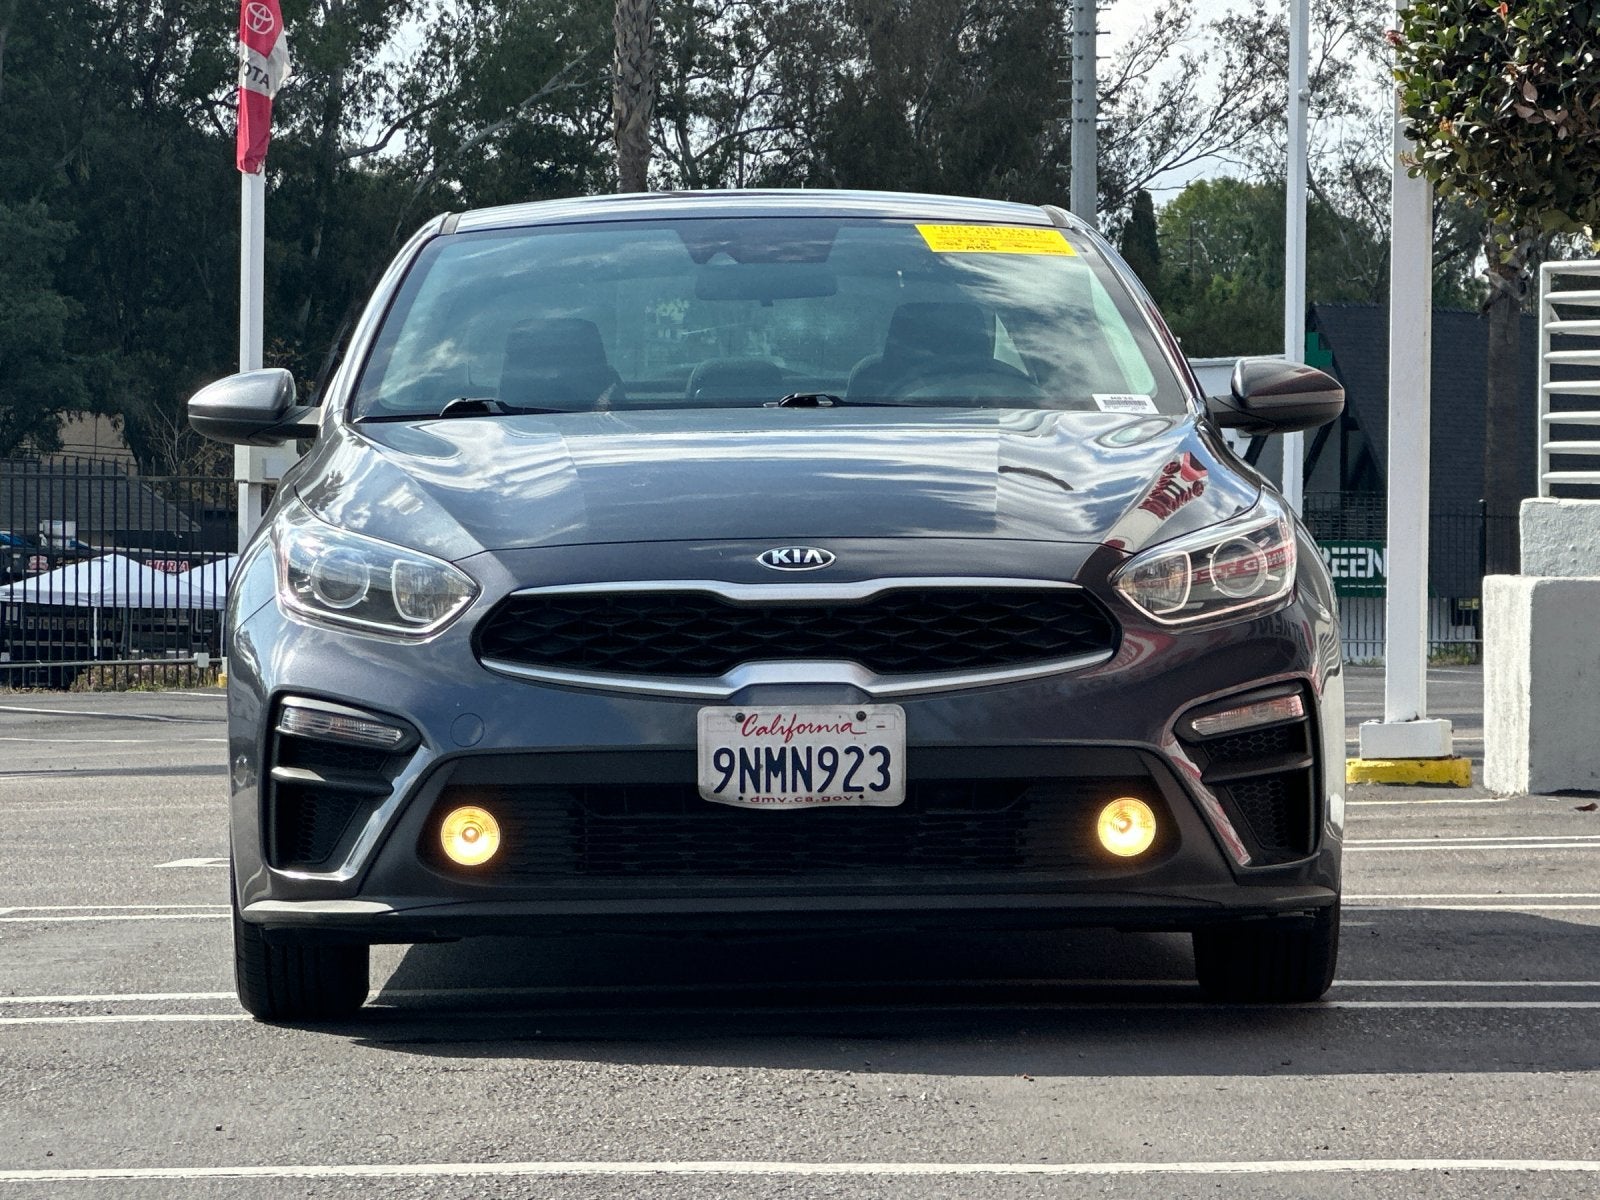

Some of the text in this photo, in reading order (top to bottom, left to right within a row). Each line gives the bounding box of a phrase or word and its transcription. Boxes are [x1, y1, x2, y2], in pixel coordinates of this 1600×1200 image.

[241, 60, 270, 90] OTA
[771, 548, 824, 565] KIA
[740, 713, 867, 744] California
[713, 745, 891, 794] 9NMN923
[750, 794, 854, 804] dmv.ca.gov
